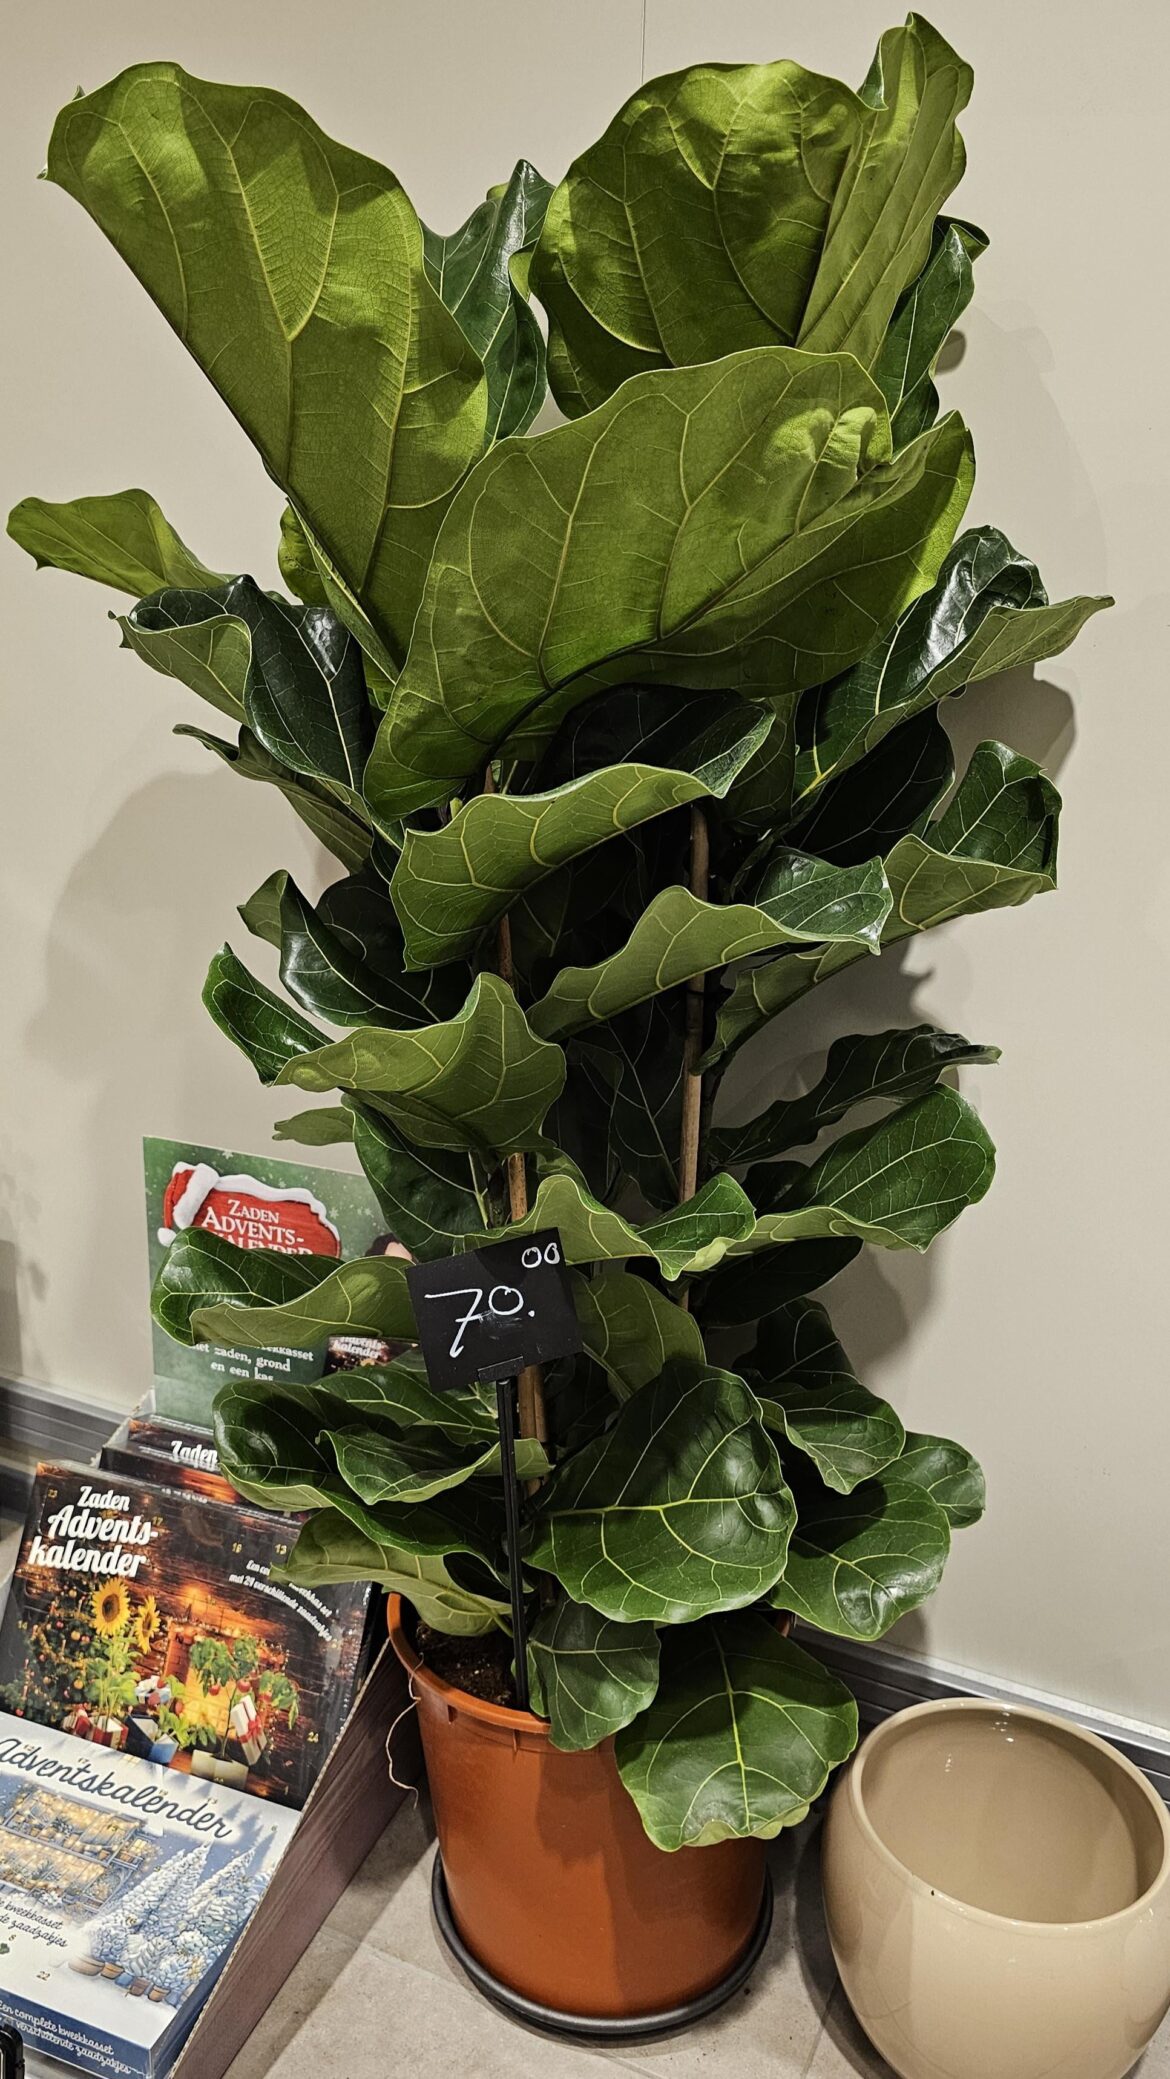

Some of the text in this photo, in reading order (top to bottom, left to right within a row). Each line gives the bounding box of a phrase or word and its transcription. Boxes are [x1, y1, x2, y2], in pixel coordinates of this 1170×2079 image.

[227, 1199, 280, 1224] ZADEN
[201, 1206, 305, 1246] ADVENTS-
[521, 1242, 560, 1268] 00
[210, 1361, 226, 1372] en
[229, 1366, 250, 1378] een
[214, 1347, 252, 1364] zaden,
[255, 1357, 291, 1372] grond
[77, 1485, 130, 1511] Zaden
[48, 1504, 158, 1545] Advents-
[27, 1536, 147, 1577] kalender
[0, 1738, 232, 1839] Adventskalender
[14, 2007, 57, 2034] complete
